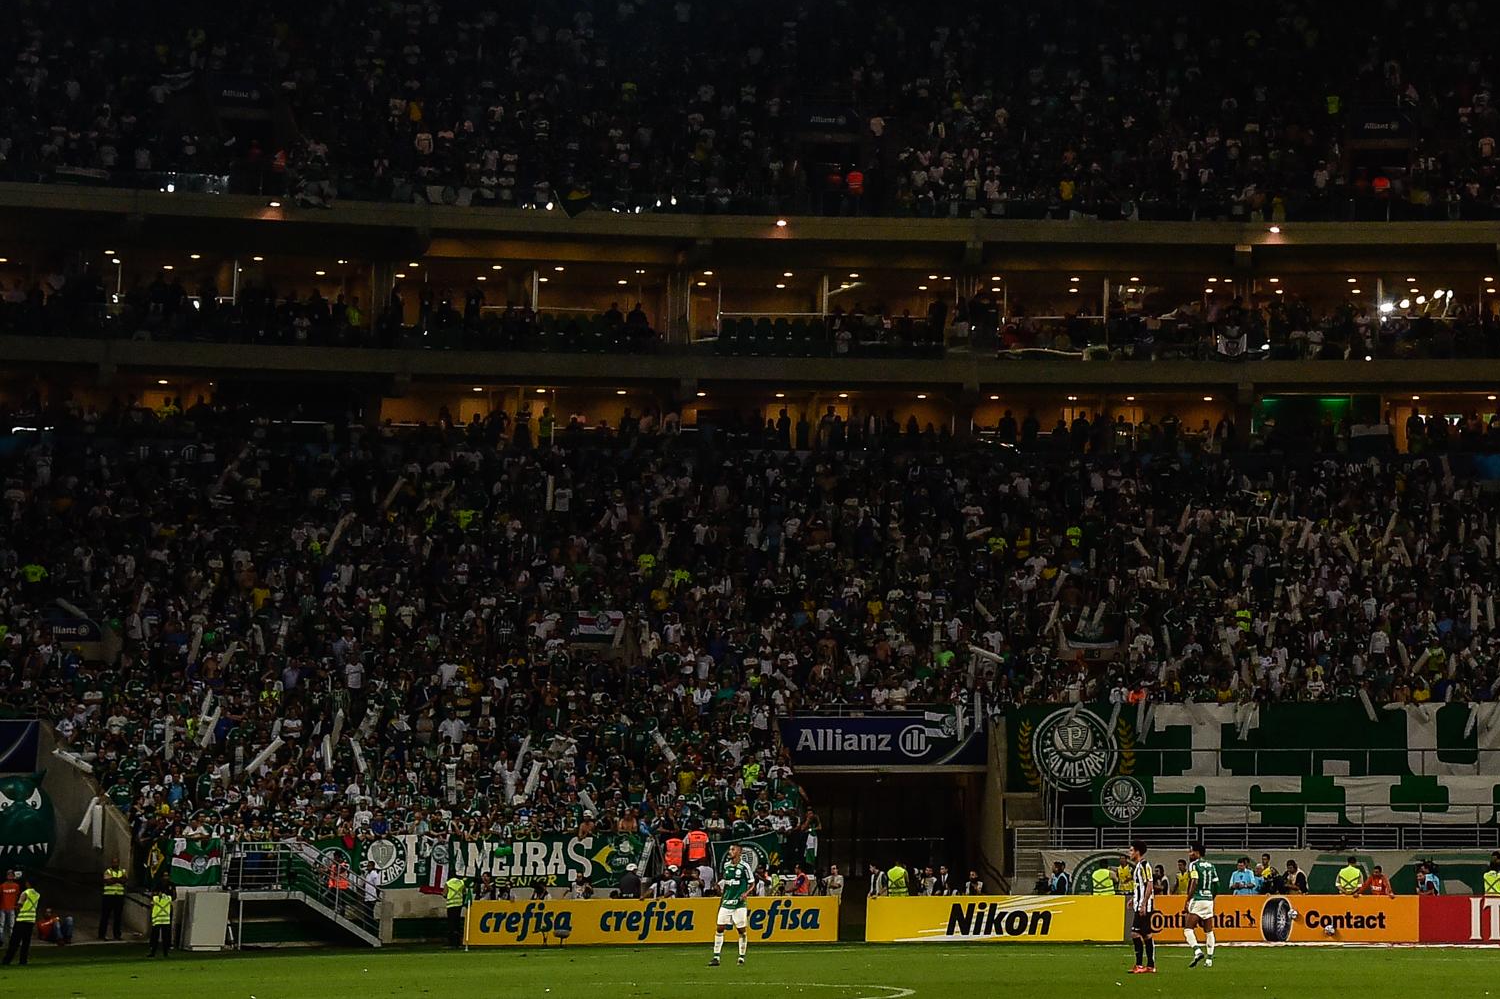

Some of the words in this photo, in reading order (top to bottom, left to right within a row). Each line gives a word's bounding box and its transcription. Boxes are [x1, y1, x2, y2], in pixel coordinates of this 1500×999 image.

[796, 727, 892, 753] Allianz
[1202, 870, 1213, 890] 11
[480, 903, 572, 941] crefisa
[600, 902, 694, 940] crefisa
[725, 900, 820, 939] efisa
[947, 902, 1052, 936] Nikon
[1306, 910, 1386, 929] Contact
